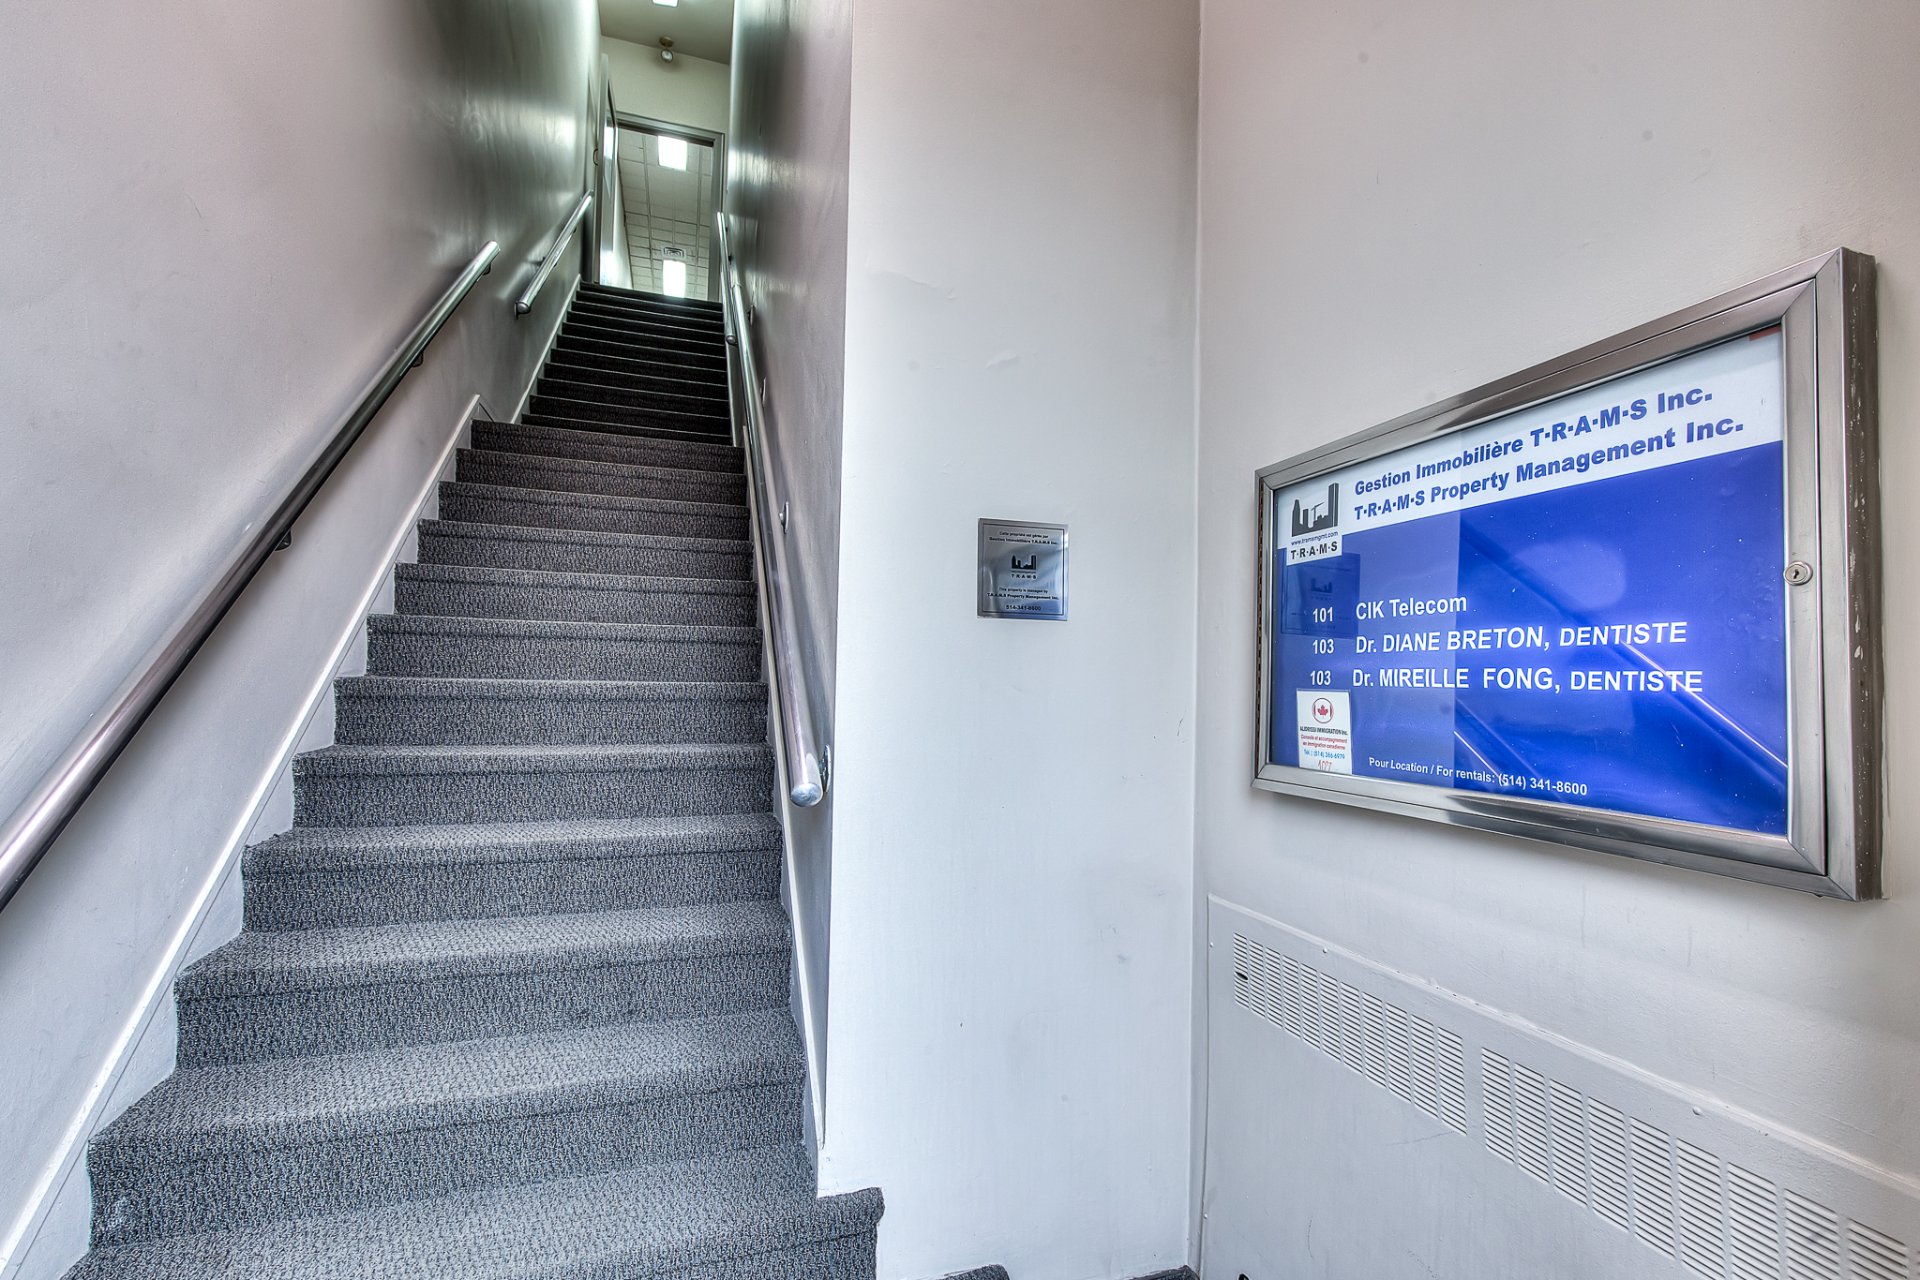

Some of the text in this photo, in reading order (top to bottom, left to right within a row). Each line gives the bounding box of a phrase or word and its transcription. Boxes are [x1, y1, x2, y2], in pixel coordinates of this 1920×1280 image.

[1355, 470, 1411, 496] Gestion
[1416, 438, 1524, 480] Immobilière
[1658, 388, 1713, 413] Inc.
[1430, 472, 1510, 502] Property
[1516, 428, 1676, 482] Management
[1686, 418, 1744, 443] Inc.
[1312, 596, 1467, 623] 101 CIK Telecom
[1312, 622, 1688, 654] 103 Dr. DIANE BRETON, DENTISTE
[1310, 668, 1703, 694] 103 Dr. MIREILLE FONG, DENTISTE
[1368, 756, 1390, 768] Pour
[1390, 760, 1428, 774] Location
[1436, 765, 1454, 776] For
[1456, 769, 1496, 784] rentals:
[1498, 773, 1527, 790] (514)
[1530, 777, 1588, 796] 341-8600
